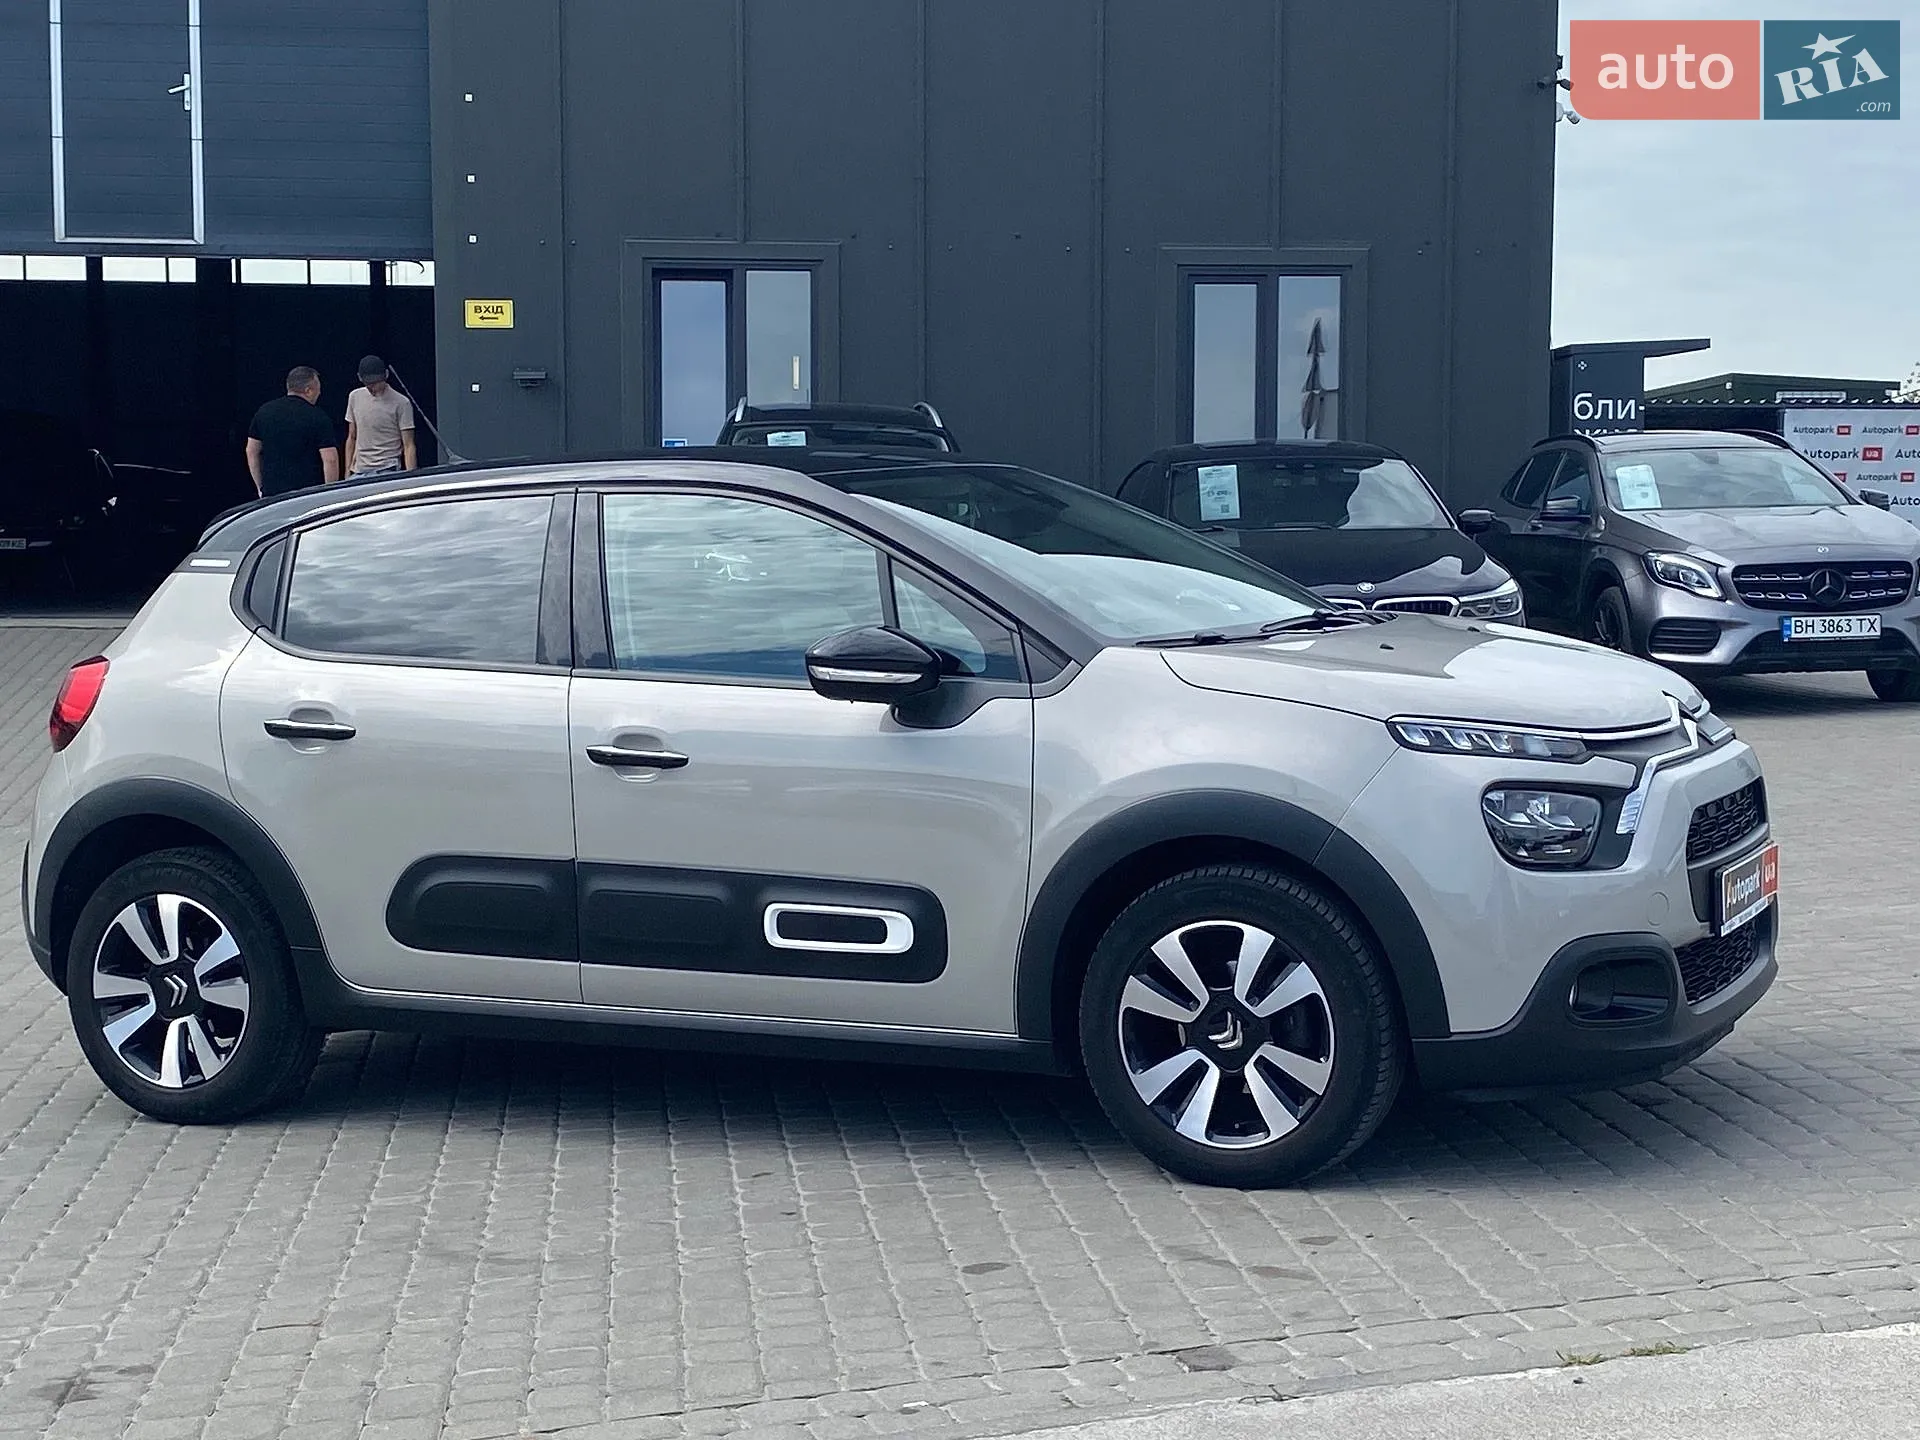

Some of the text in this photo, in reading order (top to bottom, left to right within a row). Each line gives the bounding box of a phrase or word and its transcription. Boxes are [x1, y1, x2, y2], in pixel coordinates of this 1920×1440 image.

[474, 305, 504, 315] ВХІД
[1573, 392, 1645, 420] бли-
[1793, 425, 1834, 435] Autopark
[1862, 425, 1903, 435] Autopark
[1856, 472, 1898, 482] Autopark
[1794, 618, 1878, 634] BH 3863 TX
